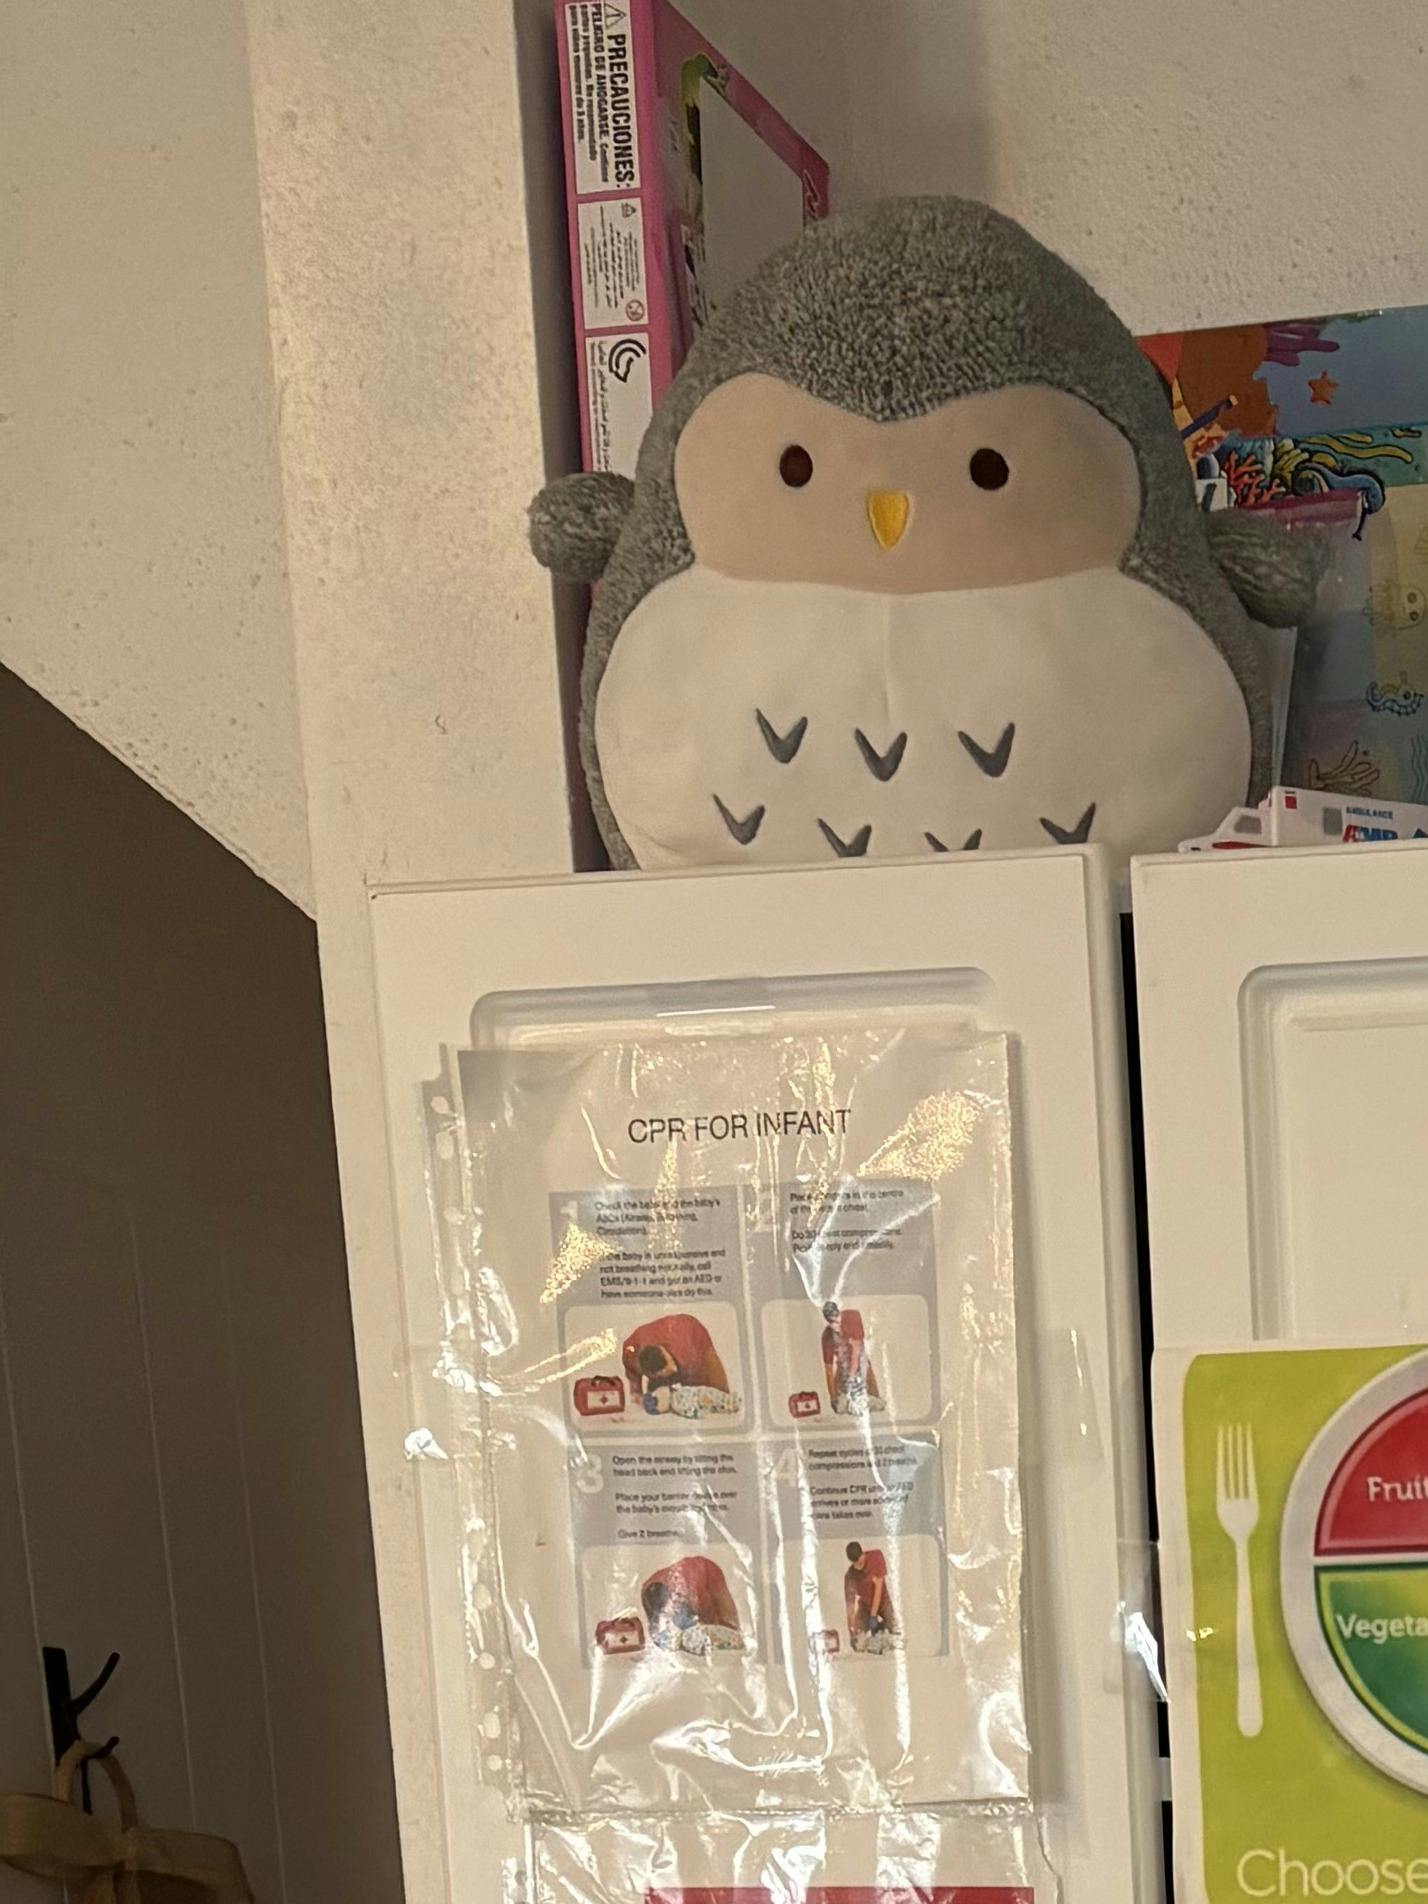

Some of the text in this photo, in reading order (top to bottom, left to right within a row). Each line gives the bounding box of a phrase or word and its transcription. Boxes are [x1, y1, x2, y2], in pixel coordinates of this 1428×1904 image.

[607, 33, 635, 188] PRECAUCIONES:
[1346, 806, 1393, 819] AMBULANCE
[628, 1107, 853, 1145] CPR FOR INFANT
